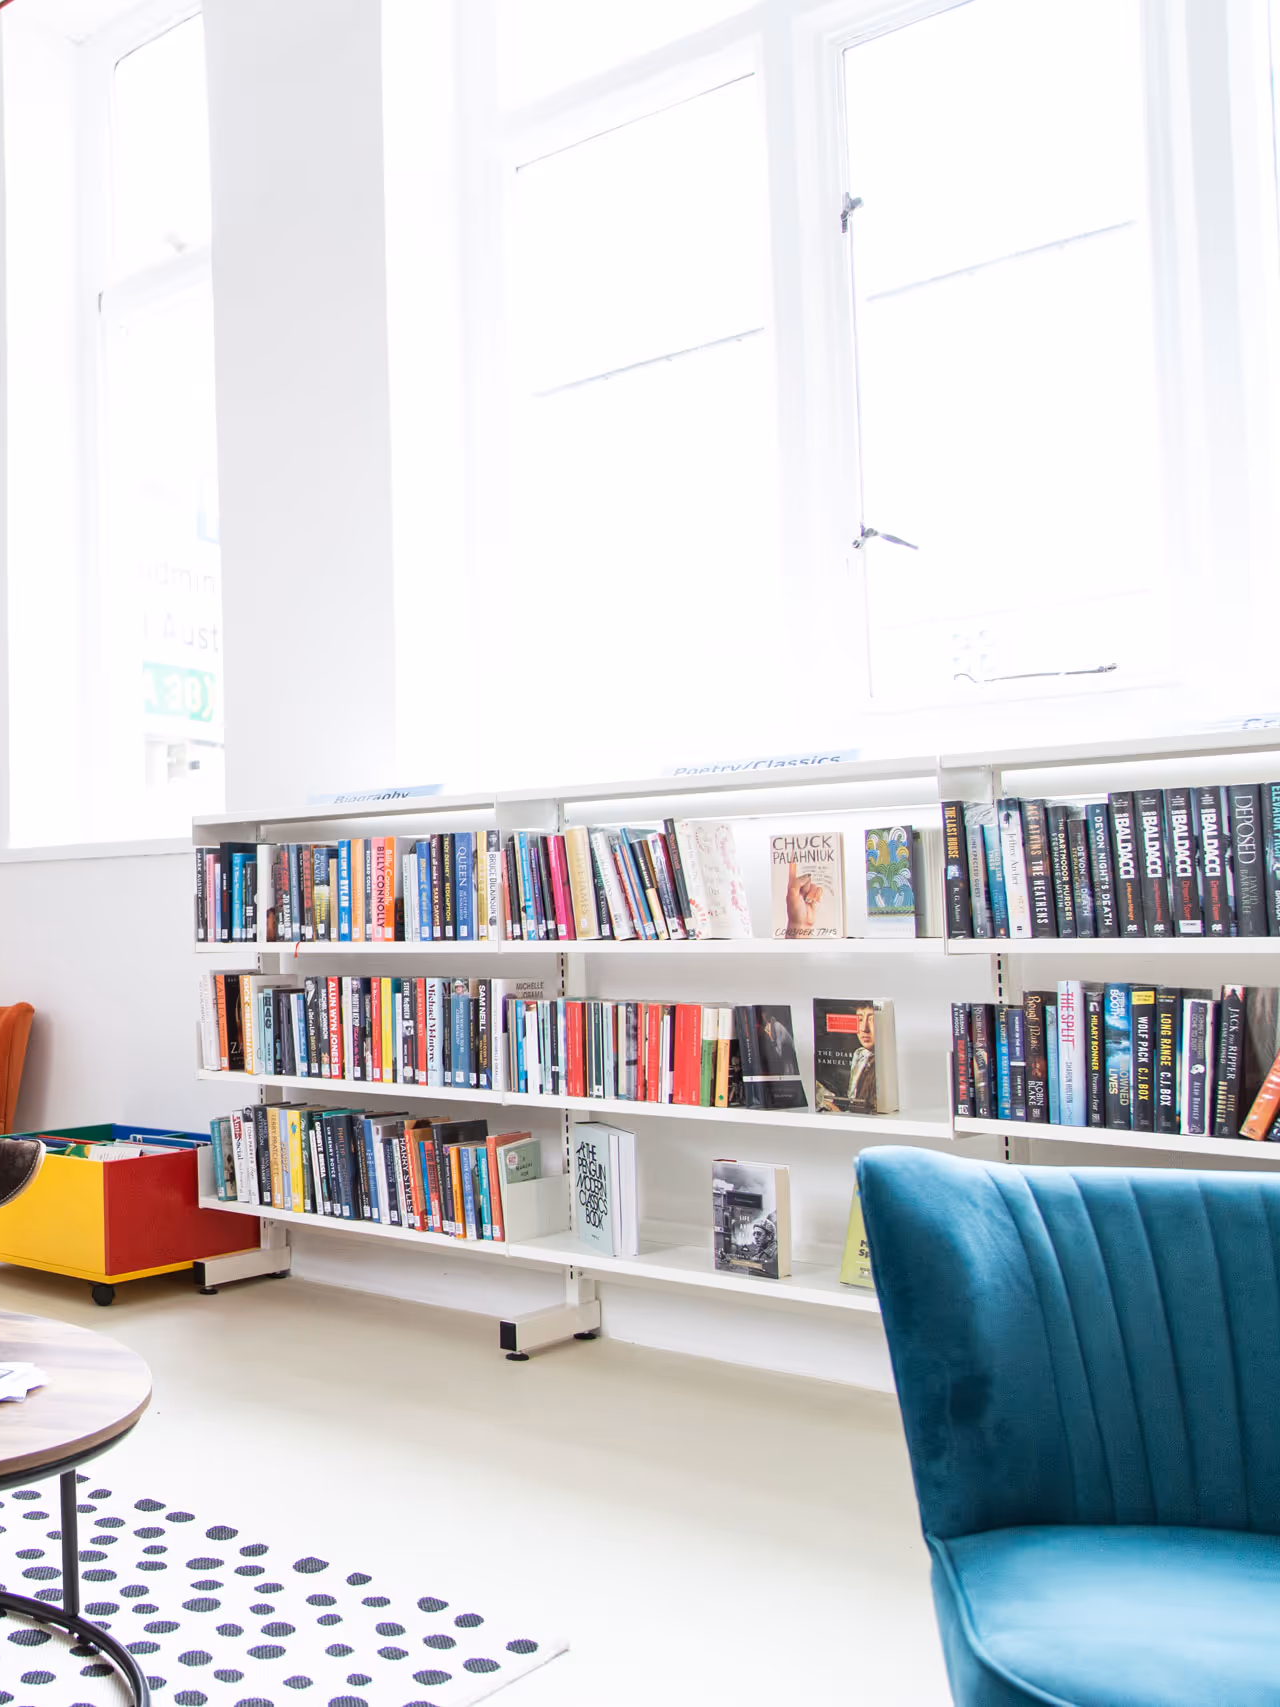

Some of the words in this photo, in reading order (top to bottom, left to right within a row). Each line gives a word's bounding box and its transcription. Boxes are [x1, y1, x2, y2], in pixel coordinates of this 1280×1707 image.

[945, 806, 956, 818] THE
[1026, 805, 1039, 820] ACE
[946, 820, 958, 836] LAST
[1028, 824, 1041, 855] ATKINS
[1094, 816, 1105, 848] DEVON
[1235, 795, 1257, 864] DEPOSED
[772, 835, 833, 851] CHUCK
[947, 838, 959, 859] HOUSE
[971, 836, 979, 876] UNEXPECTED
[1006, 833, 1017, 859] Jeffrey
[1052, 832, 1061, 876] STEPHANIE
[1115, 817, 1135, 879] BALDACCI
[1142, 815, 1162, 878] BALDACCI
[1172, 814, 1192, 877] BALDACCI
[1201, 813, 1220, 877] BALDACCI
[377, 846, 385, 873] BILLY
[385, 850, 393, 867] Billy
[457, 847, 468, 886] QUEEN
[488, 853, 496, 877] BRUCE
[773, 849, 834, 865] PALAHNIUK
[1032, 860, 1044, 876] THE
[1077, 846, 1086, 874] DEVON
[1097, 849, 1110, 890] NIGHT'S
[283, 894, 289, 903] JO
[385, 869, 393, 906] Connolly
[489, 878, 497, 914] DICKINSON
[377, 874, 385, 928] CONNOLLY
[1033, 880, 1048, 924] HEATHENS
[1063, 885, 1072, 920] MURDERS
[1081, 888, 1090, 916] DEATH
[1102, 893, 1113, 925] DEATH
[283, 905, 291, 927] BRAND
[775, 927, 814, 937] CONSIDER
[329, 981, 337, 1007] ALUN
[516, 982, 545, 990] MICHELLE
[428, 984, 436, 1021] Michael
[1060, 991, 1074, 1012] THE
[1109, 989, 1119, 1018] BOOTH
[973, 1007, 982, 1033] REQUIEM
[1061, 1014, 1075, 1050] SPLIT
[1090, 1015, 1098, 1040] HILARY
[1137, 1016, 1149, 1039] WOLF
[1160, 1013, 1172, 1036] LONG
[1228, 1007, 1240, 1032] JACK
[330, 1033, 338, 1065] JONES
[1029, 1024, 1040, 1050] Music
[817, 1058, 846, 1066] SAMUEL
[957, 1040, 965, 1064] DEATH
[1091, 1041, 1099, 1070] BONNER
[1137, 1041, 1149, 1063] PACK
[1160, 1038, 1172, 1066] RANGE
[1227, 1045, 1238, 1080] RIPPER
[1108, 1068, 1118, 1095] LIVES
[1138, 1067, 1149, 1082] C.J.
[1160, 1072, 1172, 1087] C.J.
[1028, 1080, 1036, 1106] BLAKE
[1035, 1081, 1044, 1106] ROBIN
[1138, 1084, 1149, 1101] BOX
[1160, 1089, 1172, 1106] BOX
[314, 1122, 323, 1152] GOODBYE
[337, 1128, 345, 1153] PHILLIP
[318, 1153, 326, 1178] RUSSIA
[400, 1138, 408, 1171] HARRY
[404, 1174, 414, 1212] STYLES
[578, 1156, 607, 1182] PENGUIN
[576, 1173, 607, 1199] MODERN
[579, 1189, 608, 1216] CLASSICS
[585, 1207, 604, 1231] BOOK
